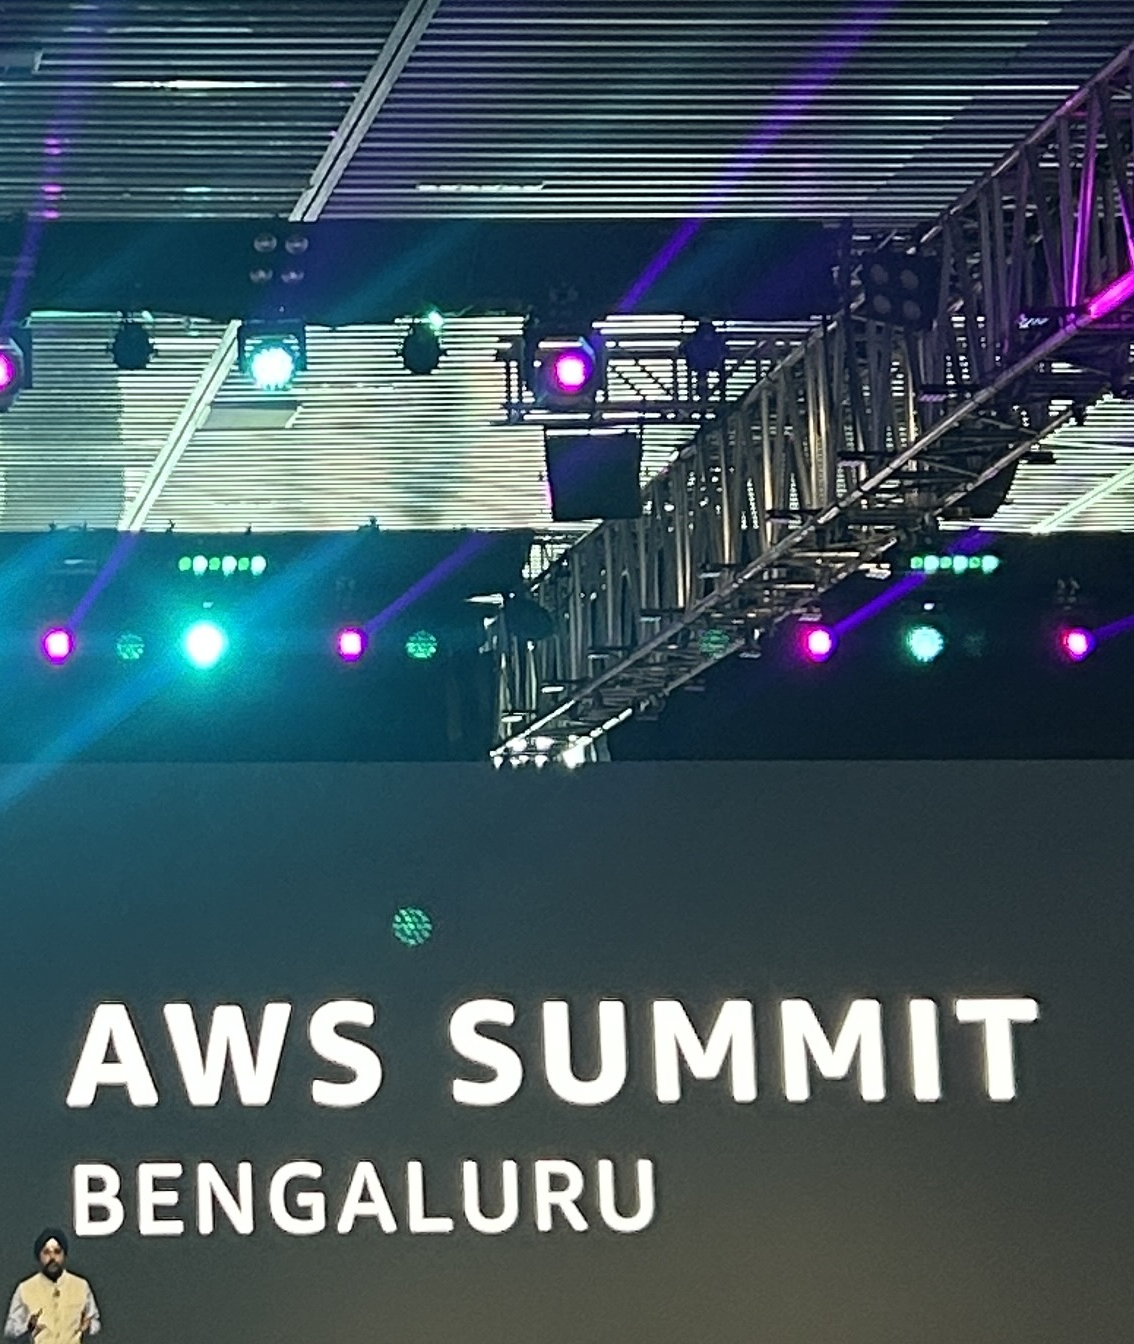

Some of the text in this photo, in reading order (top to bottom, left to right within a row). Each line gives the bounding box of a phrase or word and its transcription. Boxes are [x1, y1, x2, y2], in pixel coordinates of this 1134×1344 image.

[66, 998, 1038, 1107] AWS SUMMIT
[73, 1158, 654, 1236] BENGALURU
